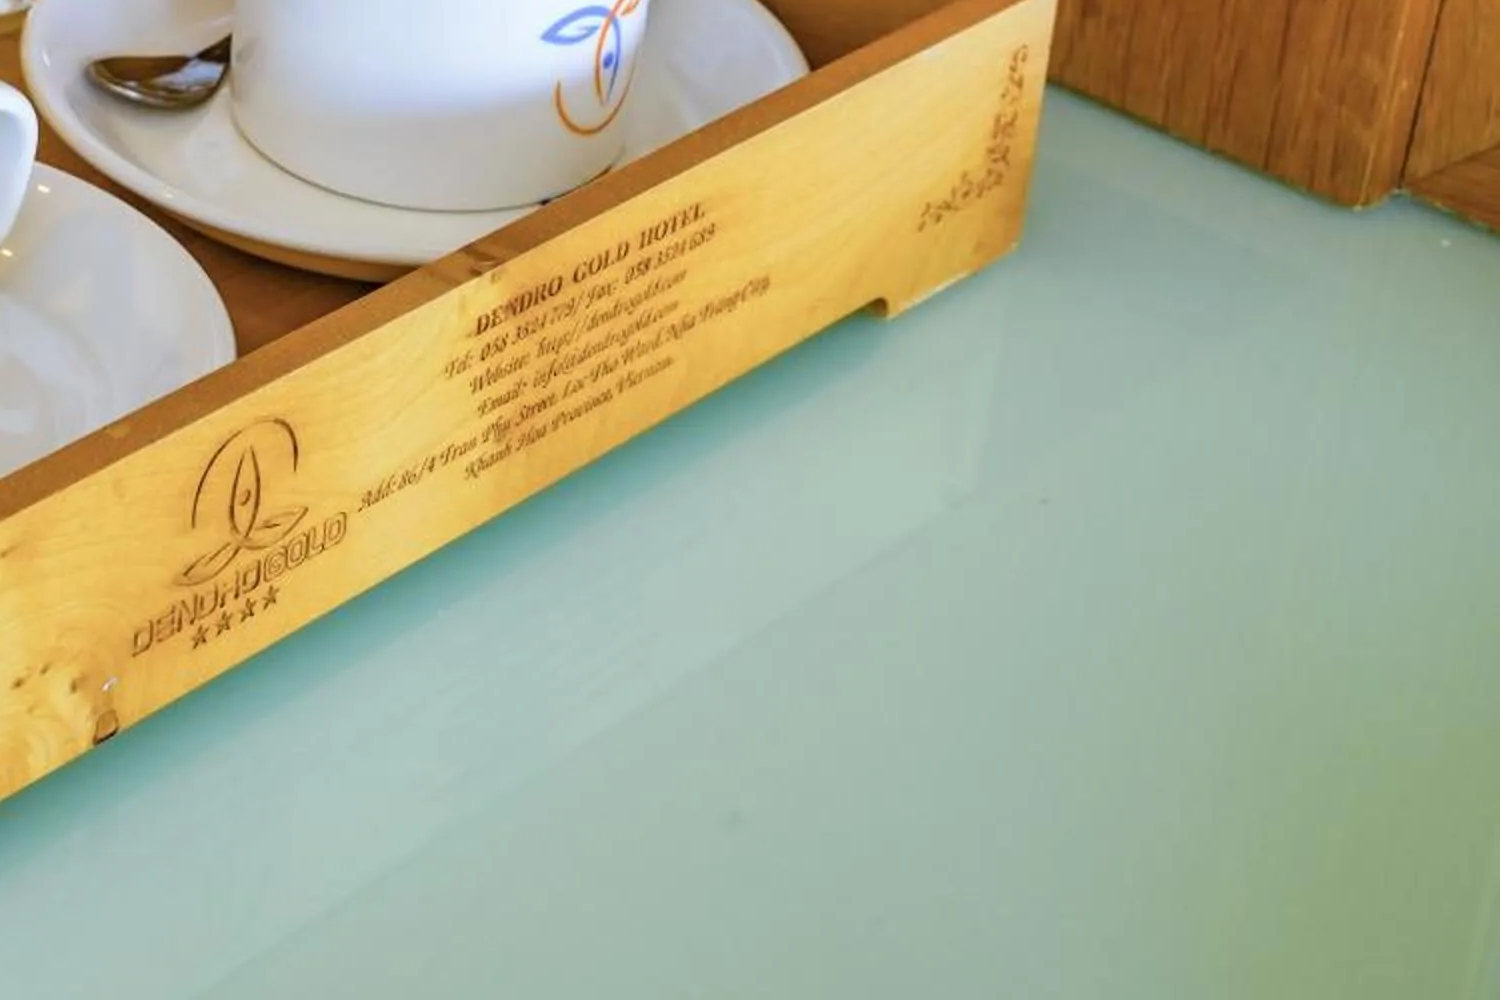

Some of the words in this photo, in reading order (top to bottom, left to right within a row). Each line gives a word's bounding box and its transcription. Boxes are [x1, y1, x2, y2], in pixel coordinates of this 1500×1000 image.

[475, 275, 564, 336] DENDRO
[572, 240, 631, 283] GOLD
[638, 203, 706, 251] HOTEL
